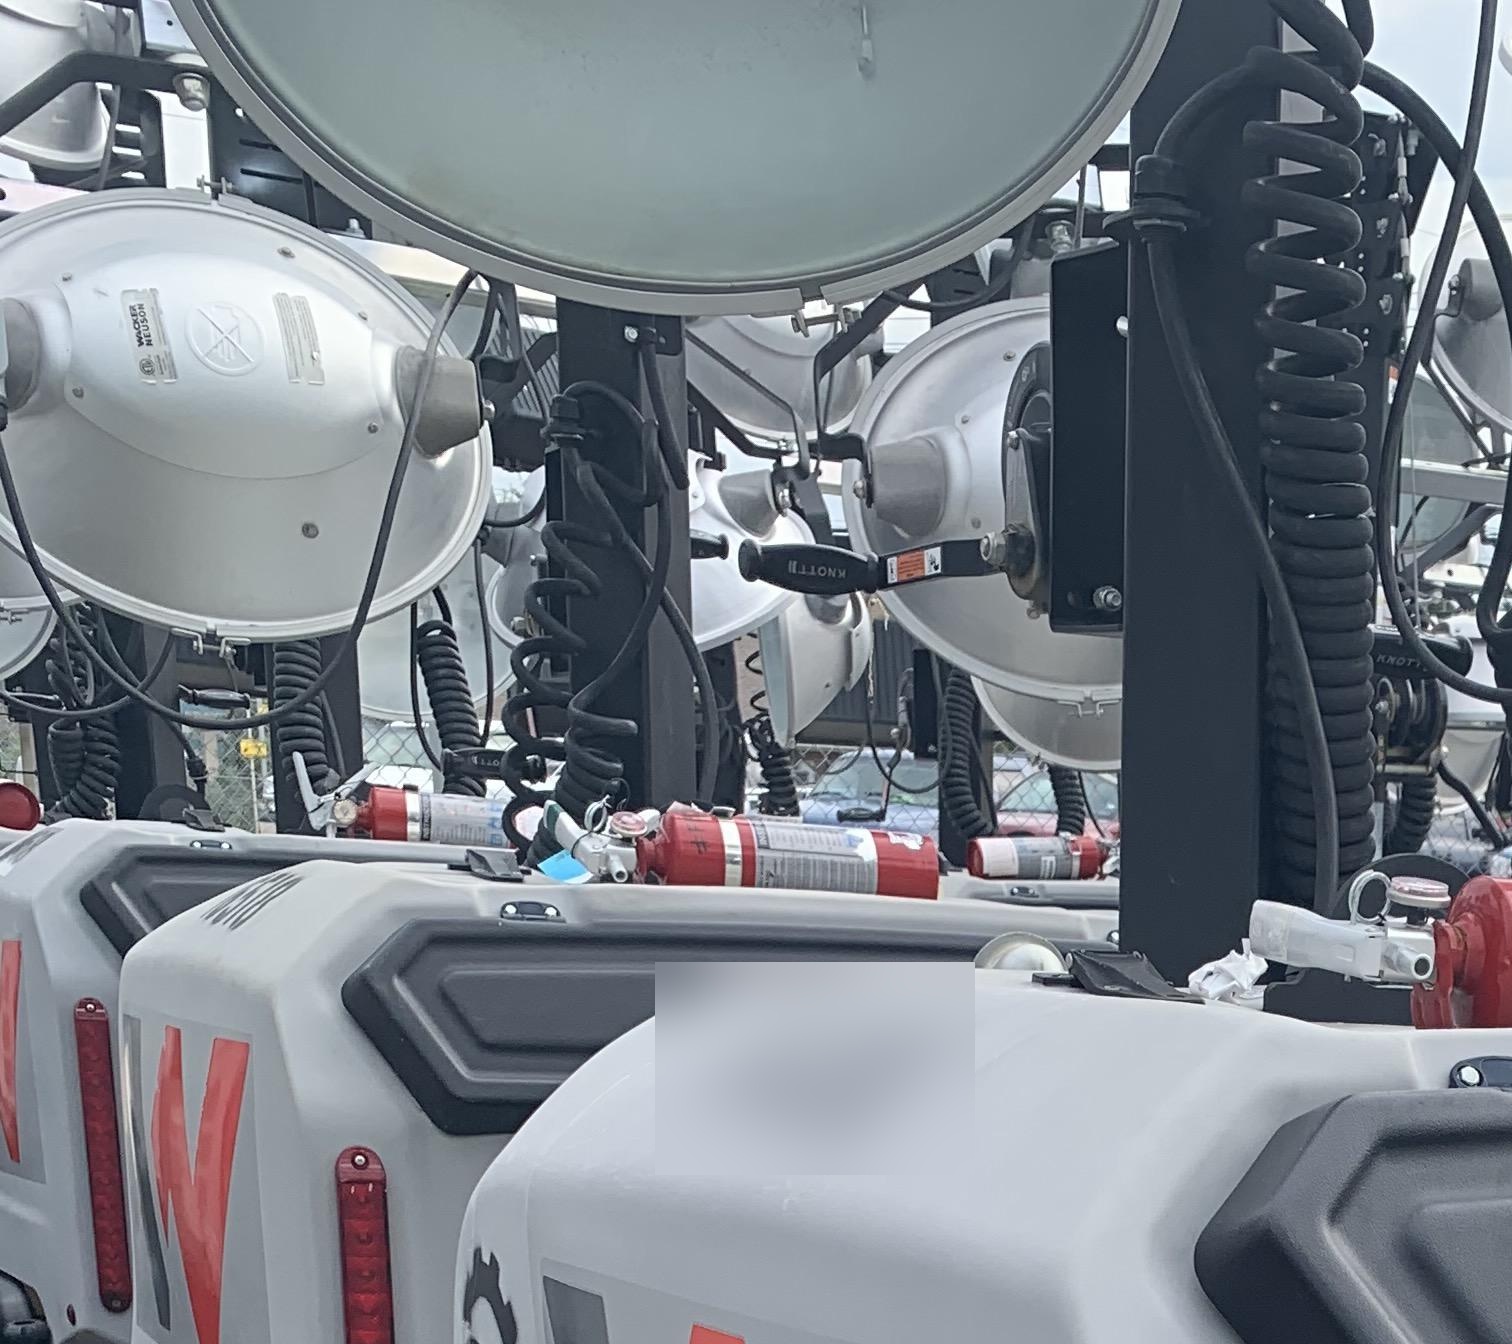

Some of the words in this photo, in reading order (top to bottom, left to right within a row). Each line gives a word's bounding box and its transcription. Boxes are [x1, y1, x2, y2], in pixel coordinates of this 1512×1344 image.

[129, 305, 144, 347] WACKER
[137, 303, 154, 347] NEUSON
[799, 564, 847, 580] KNOTT
